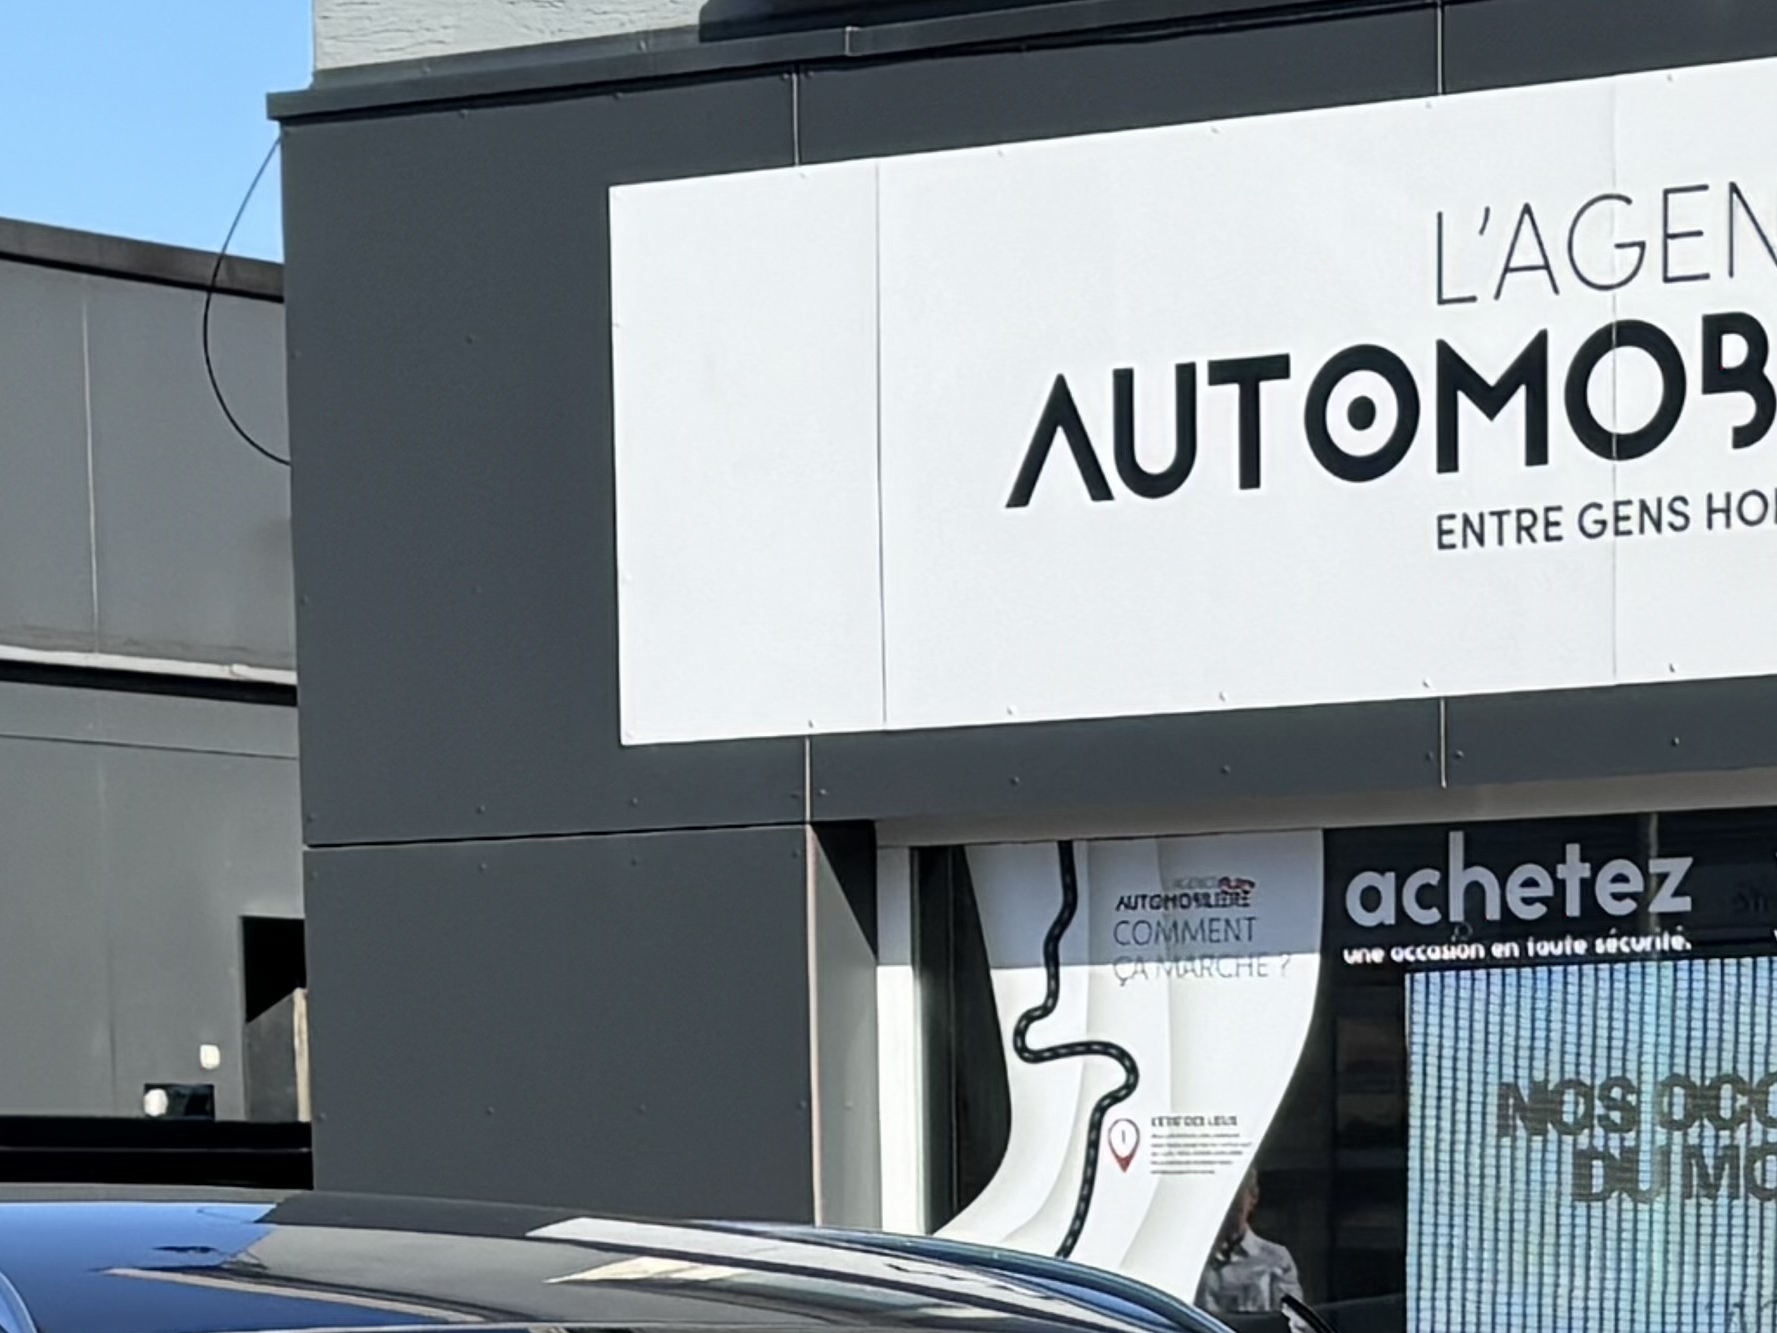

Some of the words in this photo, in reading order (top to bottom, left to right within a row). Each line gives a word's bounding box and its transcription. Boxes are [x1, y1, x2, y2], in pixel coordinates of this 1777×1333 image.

[1436, 504, 1563, 551] ENTRE
[1577, 494, 1691, 540] GENS
[1345, 830, 1694, 928] achetez
[1113, 916, 1257, 946] COMMENT
[1343, 946, 1385, 965] une
[1391, 940, 1485, 963] occasion
[1491, 941, 1520, 959] en
[1526, 935, 1588, 957] toute
[1595, 925, 1692, 953] sécurité.
[1113, 955, 1148, 986] ÇA
[1156, 950, 1270, 980] MARCHE
[1496, 1073, 1638, 1137] NOS
[1573, 1146, 1663, 1202] DU
